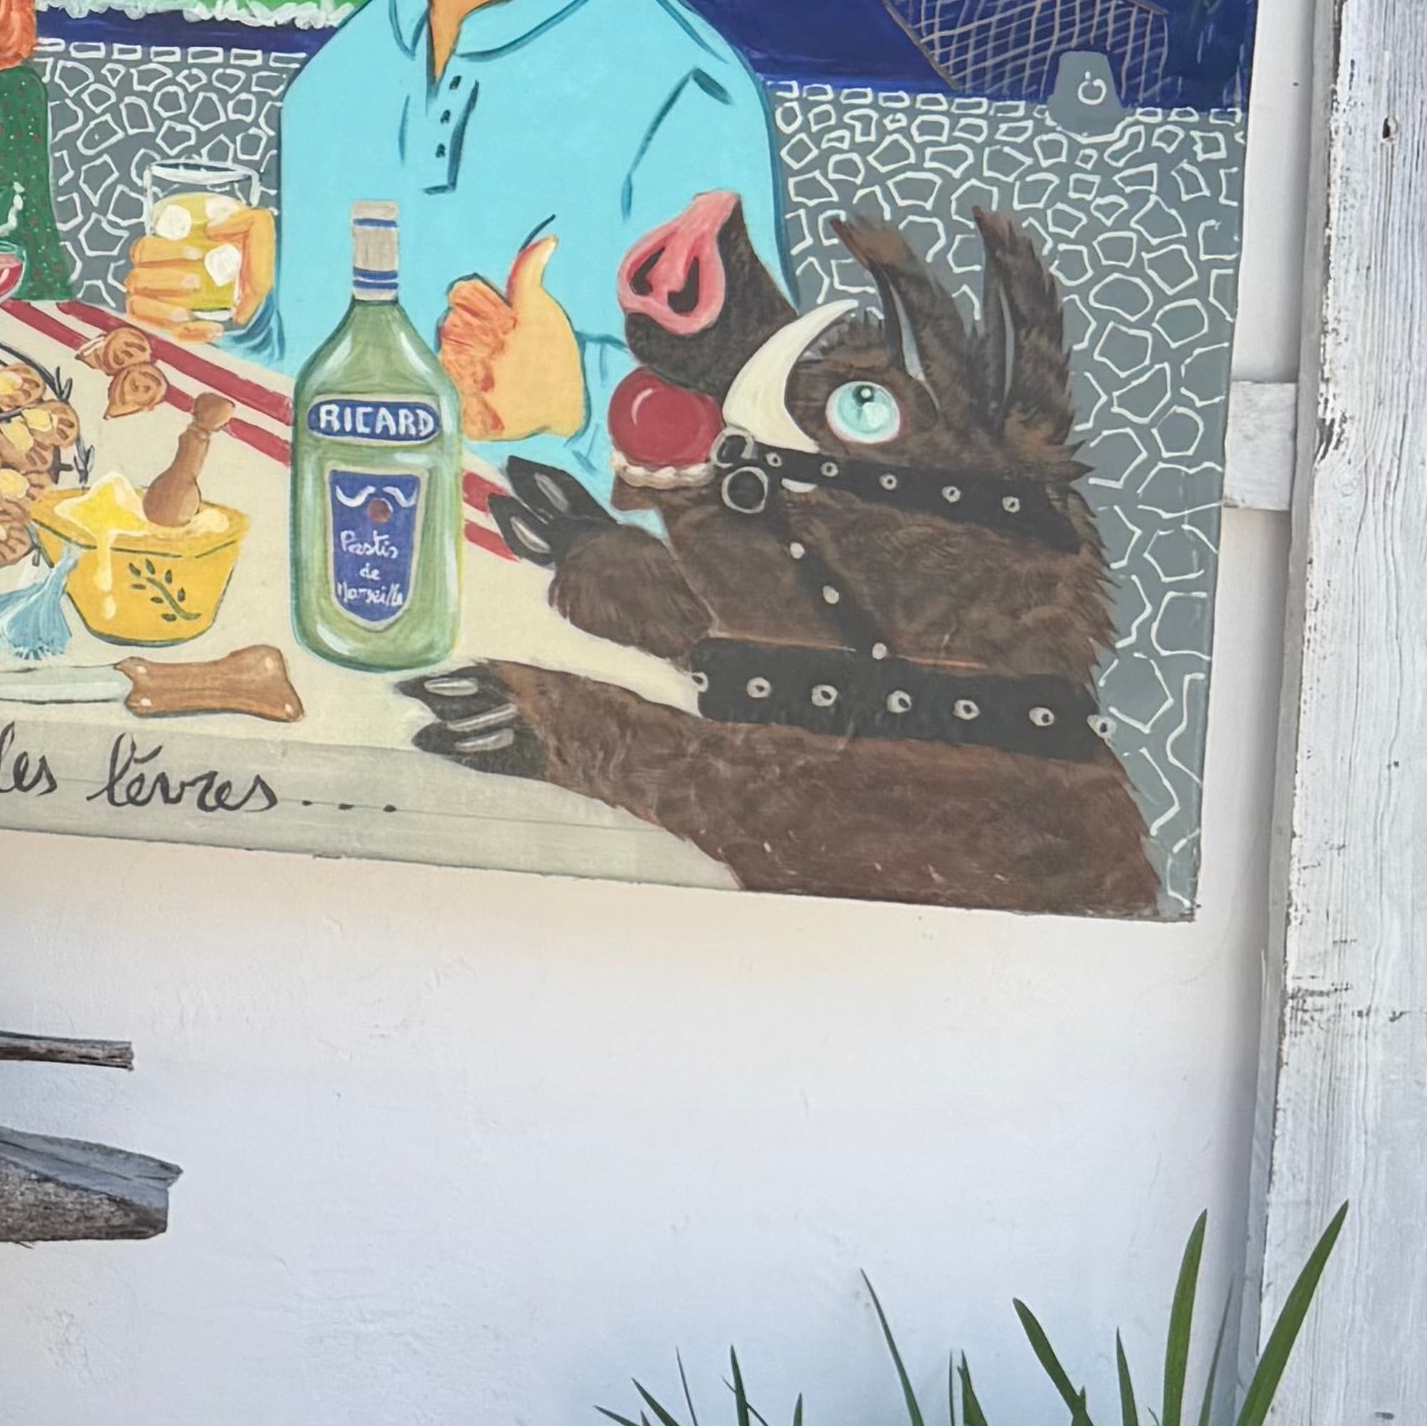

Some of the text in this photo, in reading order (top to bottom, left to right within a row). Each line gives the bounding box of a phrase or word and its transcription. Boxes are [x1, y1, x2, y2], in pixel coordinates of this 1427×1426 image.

[319, 403, 435, 437] RICARD
[340, 529, 399, 559] Pastis
[359, 562, 381, 581] de
